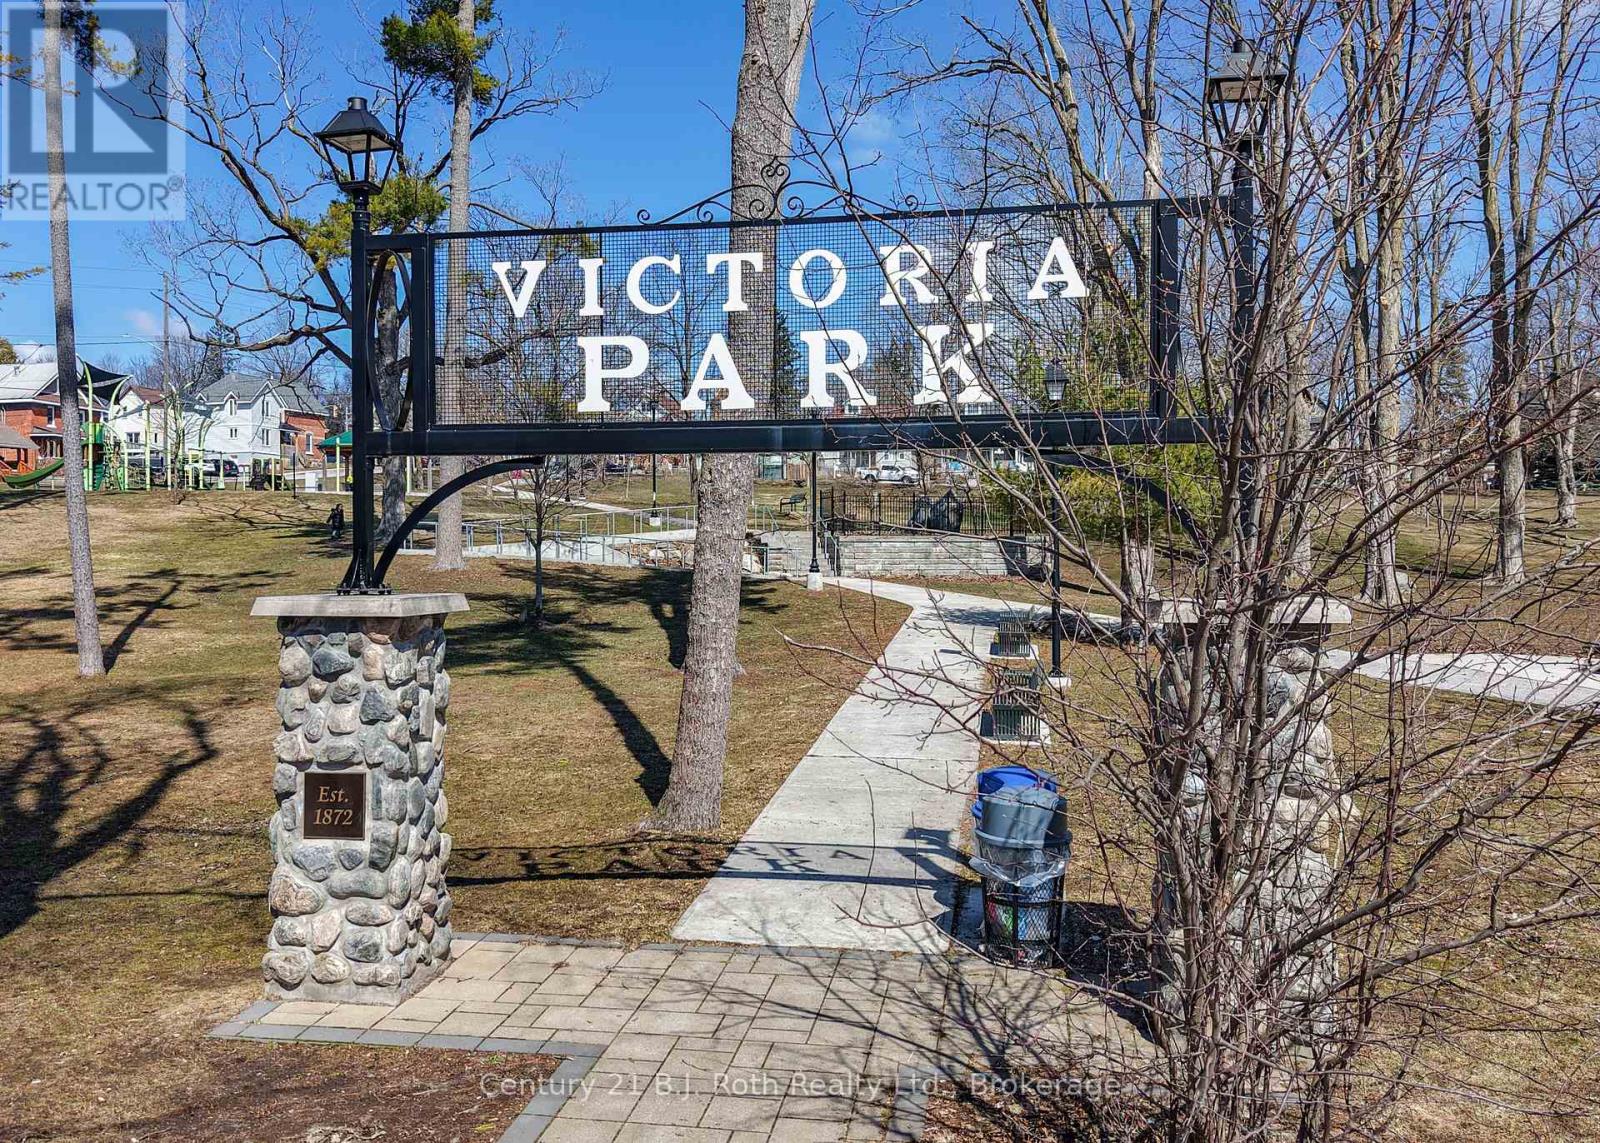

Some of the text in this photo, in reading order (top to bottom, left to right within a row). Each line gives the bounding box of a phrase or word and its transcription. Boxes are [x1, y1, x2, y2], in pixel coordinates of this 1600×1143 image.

[491, 236, 1089, 318] VICTORIA
[576, 322, 995, 413] PARK
[313, 808, 353, 825] 1872
[317, 786, 349, 803] Est.
